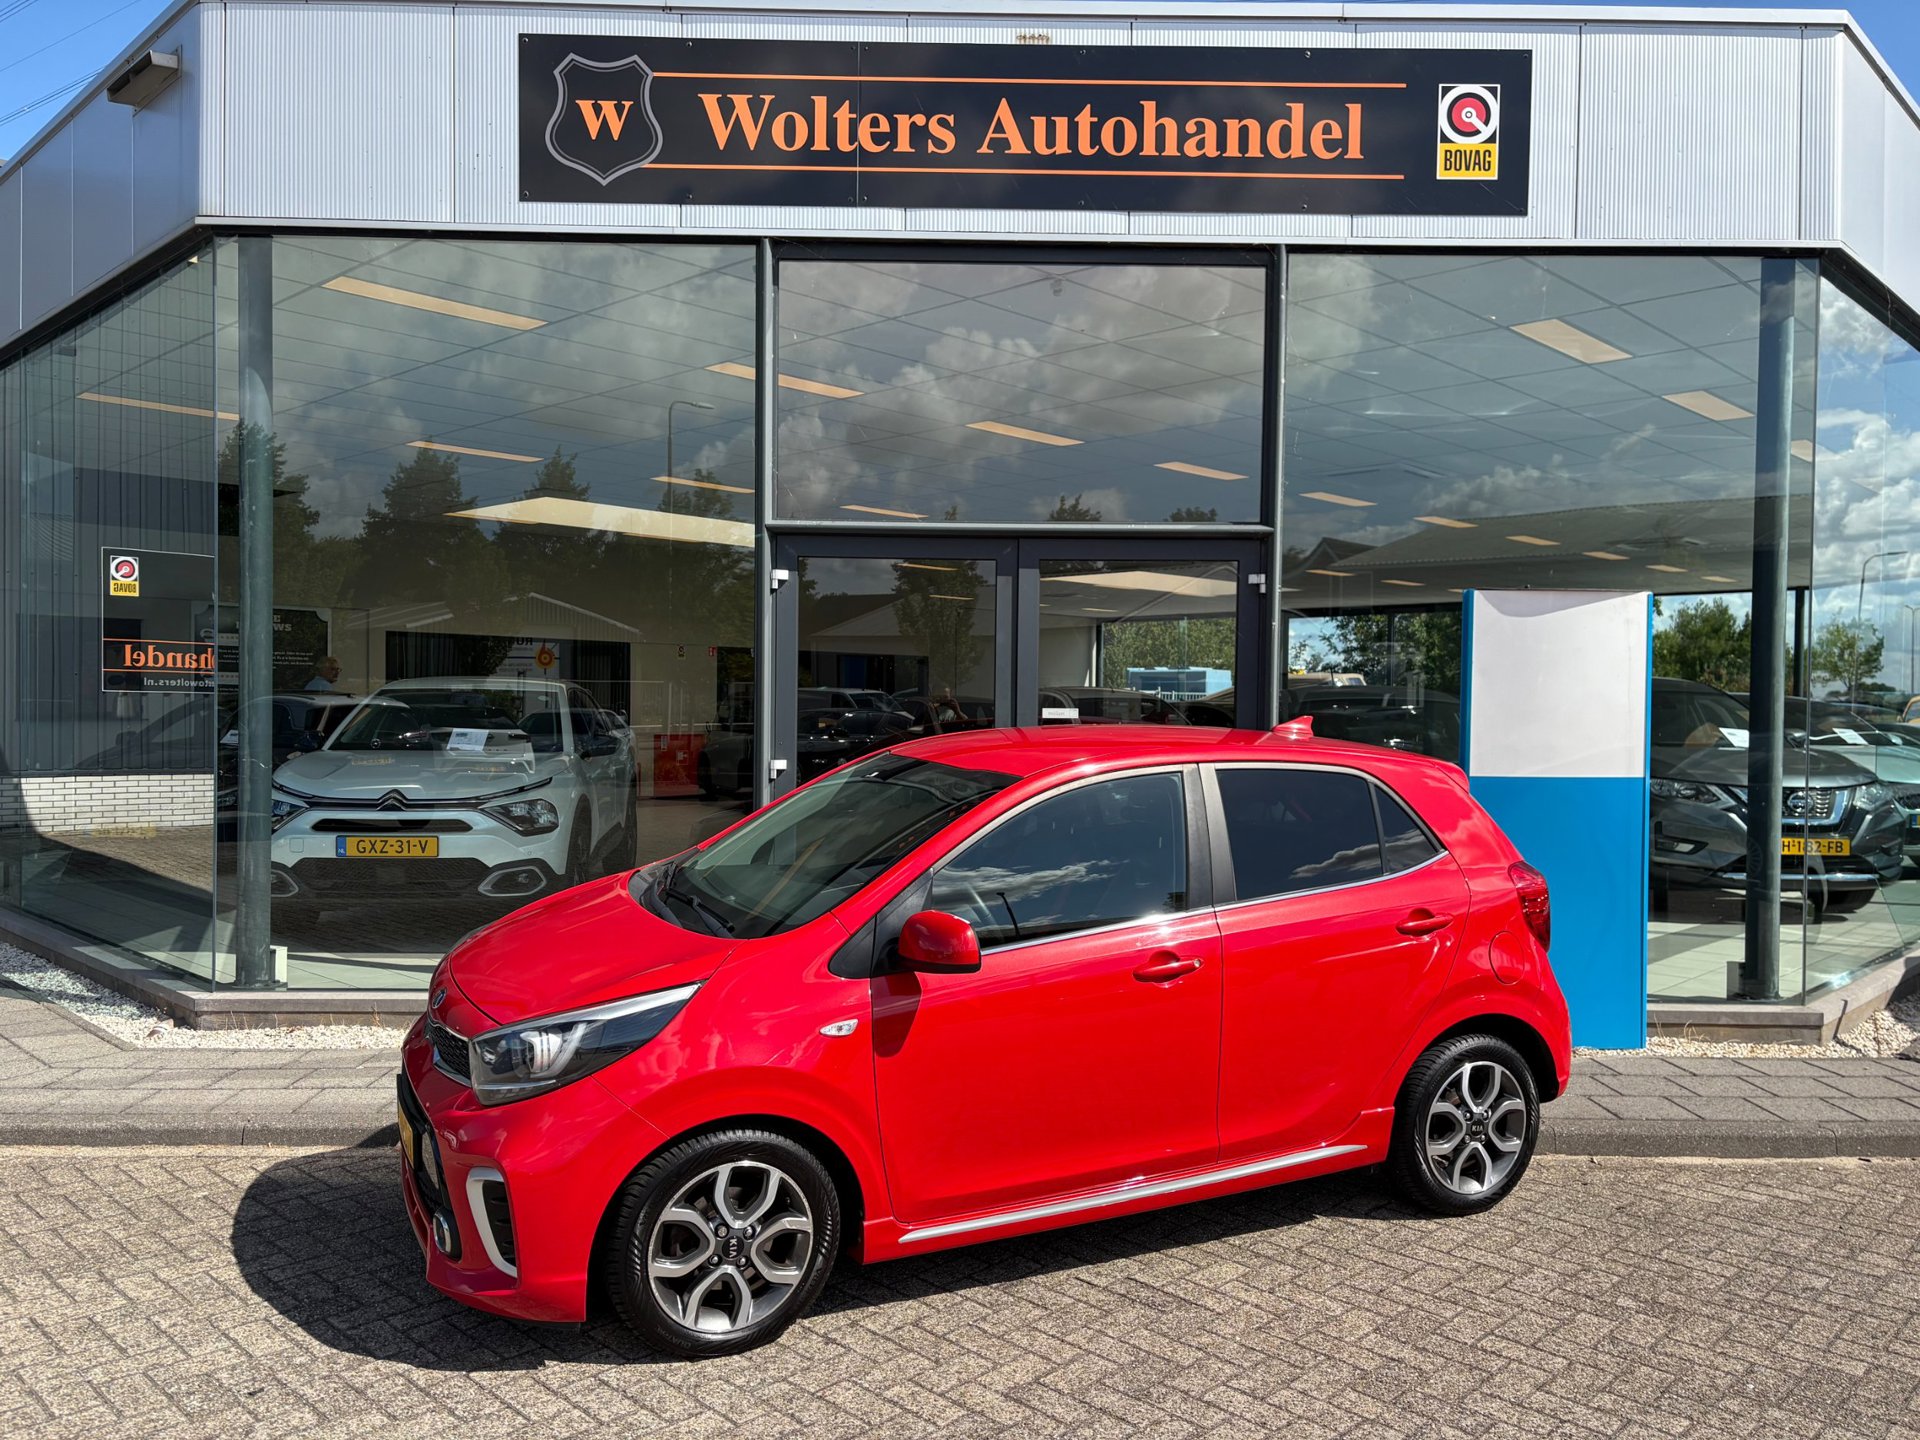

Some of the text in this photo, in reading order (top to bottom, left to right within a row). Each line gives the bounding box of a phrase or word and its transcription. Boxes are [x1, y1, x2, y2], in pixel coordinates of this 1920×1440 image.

[576, 101, 633, 141] W
[698, 93, 1364, 159] Wolters Autohandel
[1444, 149, 1491, 171] BOVAG
[356, 839, 429, 854] GXZ-31-V
[728, 1238, 738, 1258] KIA
